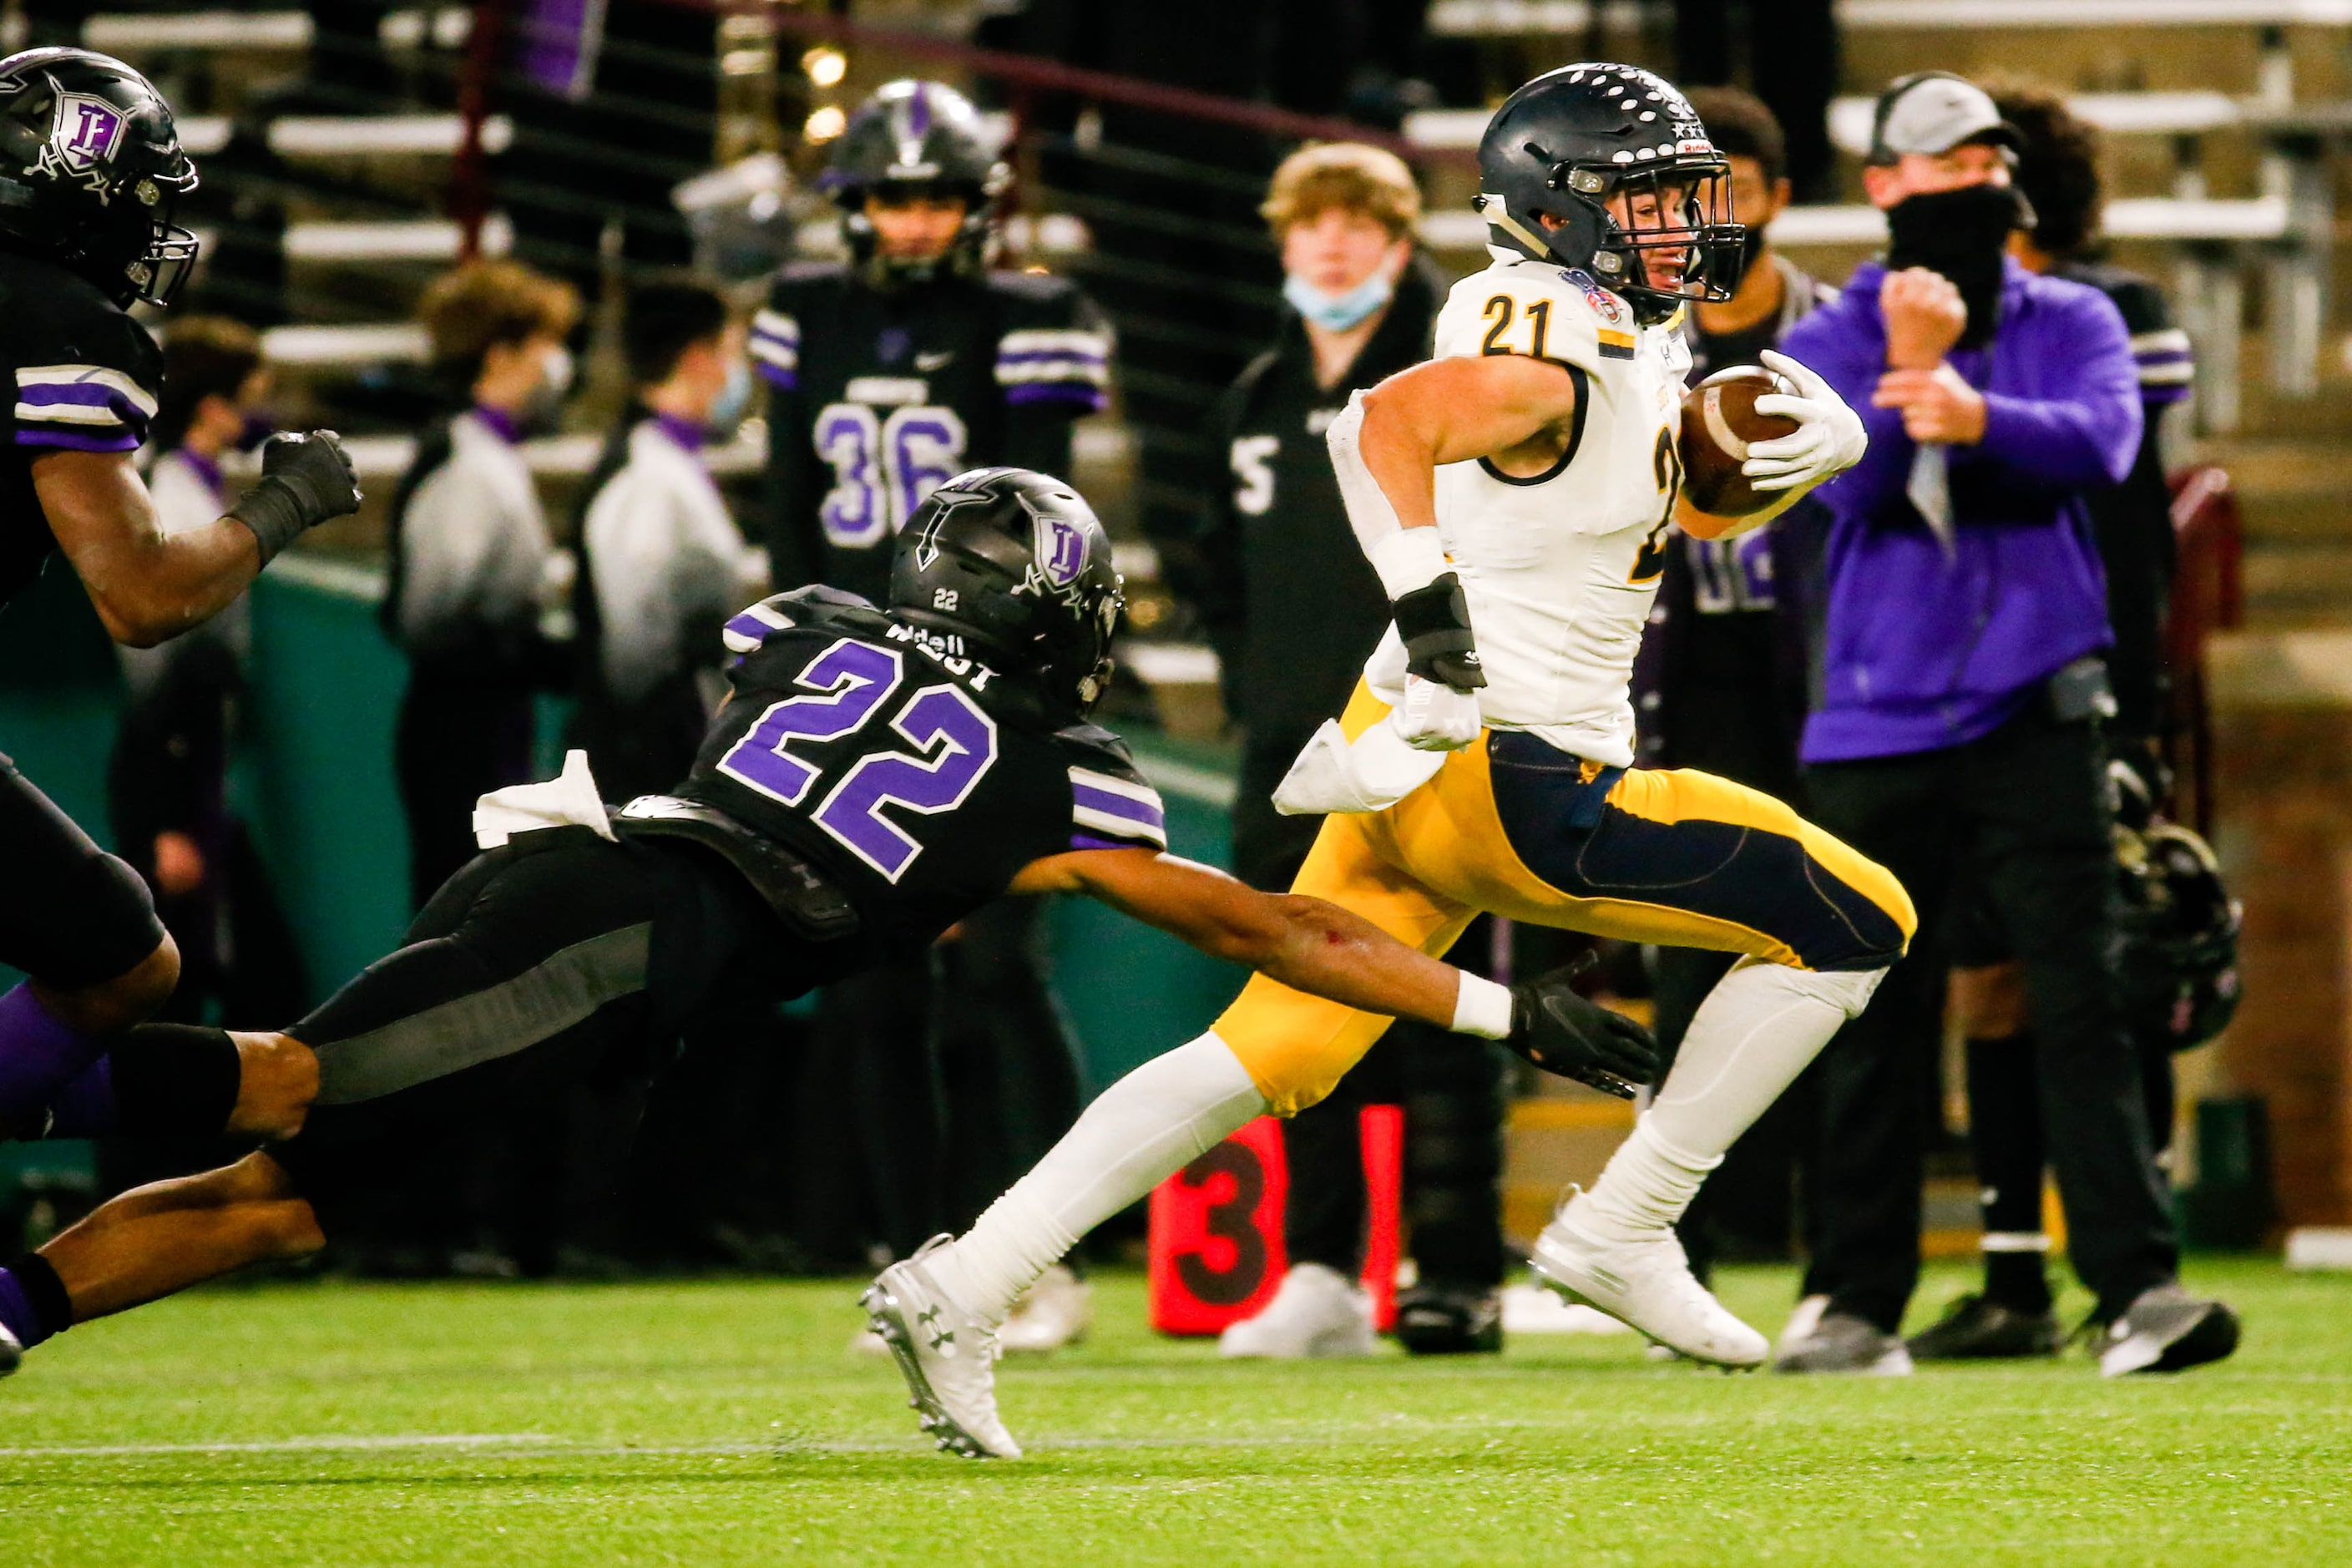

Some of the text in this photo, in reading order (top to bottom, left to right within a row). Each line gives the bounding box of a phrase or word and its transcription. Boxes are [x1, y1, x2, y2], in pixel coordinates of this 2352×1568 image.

[1479, 292, 1554, 357] 21
[1230, 435, 1281, 515] 5
[933, 587, 959, 611] 22
[716, 637, 999, 886] 22
[1173, 1140, 1267, 1306] 3
